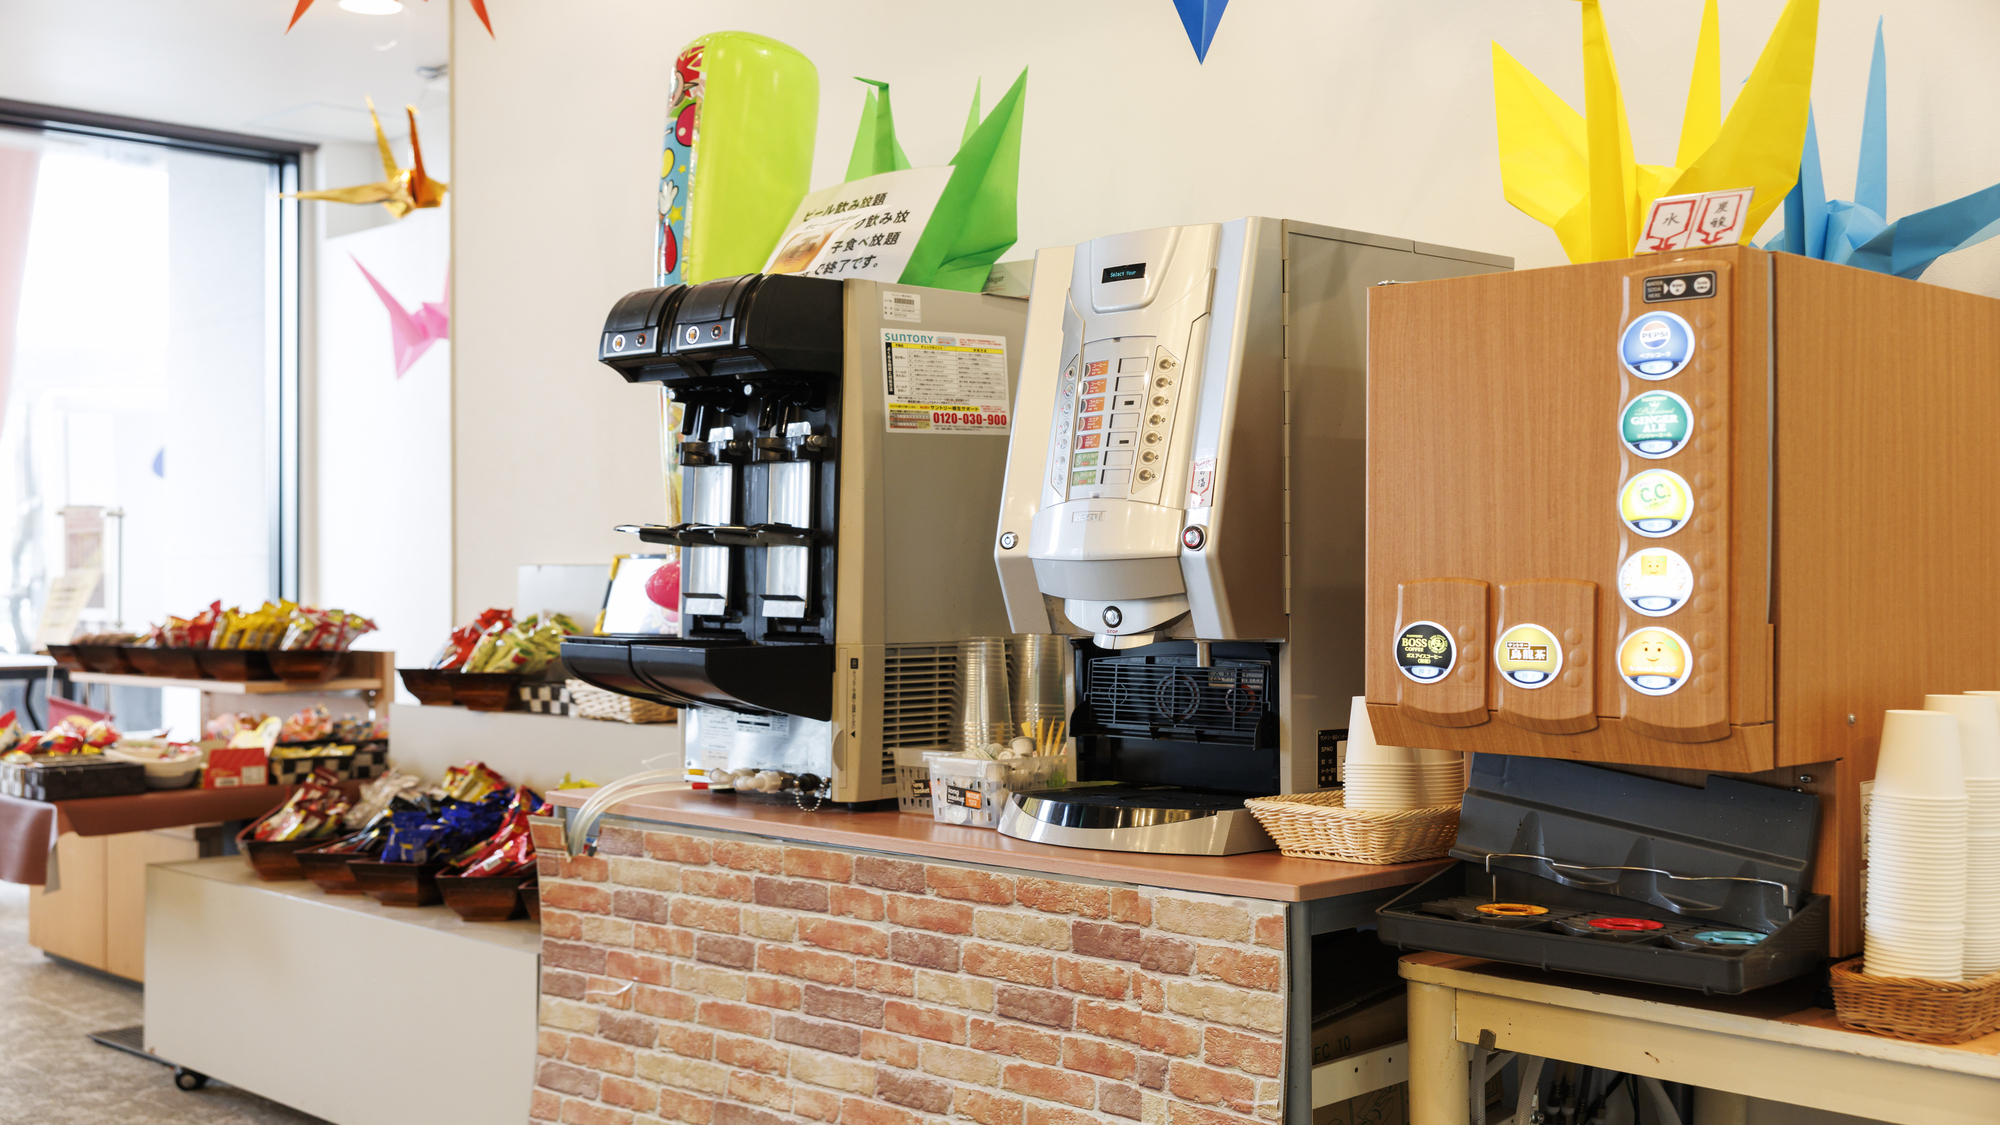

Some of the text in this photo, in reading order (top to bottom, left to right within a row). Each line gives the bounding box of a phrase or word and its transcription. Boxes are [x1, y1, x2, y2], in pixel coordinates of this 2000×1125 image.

[803, 192, 888, 222] ビール飲み放題
[1662, 212, 1680, 226] 水
[1709, 200, 1729, 228] 炭酸
[831, 231, 902, 254] 子食べ放題
[884, 332, 934, 344] SUNTORY
[1642, 331, 1669, 339] PEPSI
[1639, 351, 1672, 359] ペプシコーラ
[933, 412, 1007, 426] 0120-030-900
[1630, 414, 1679, 425] GINGER
[1642, 423, 1667, 433] ALE
[1640, 483, 1671, 503] C.C.
[1401, 637, 1428, 648] BOSS
[1406, 652, 1443, 660] ボスアイスコーヒー
[1510, 649, 1546, 660] 烏龍茶
[948, 786, 960, 797] long
[1338, 1035, 1351, 1054] 10
